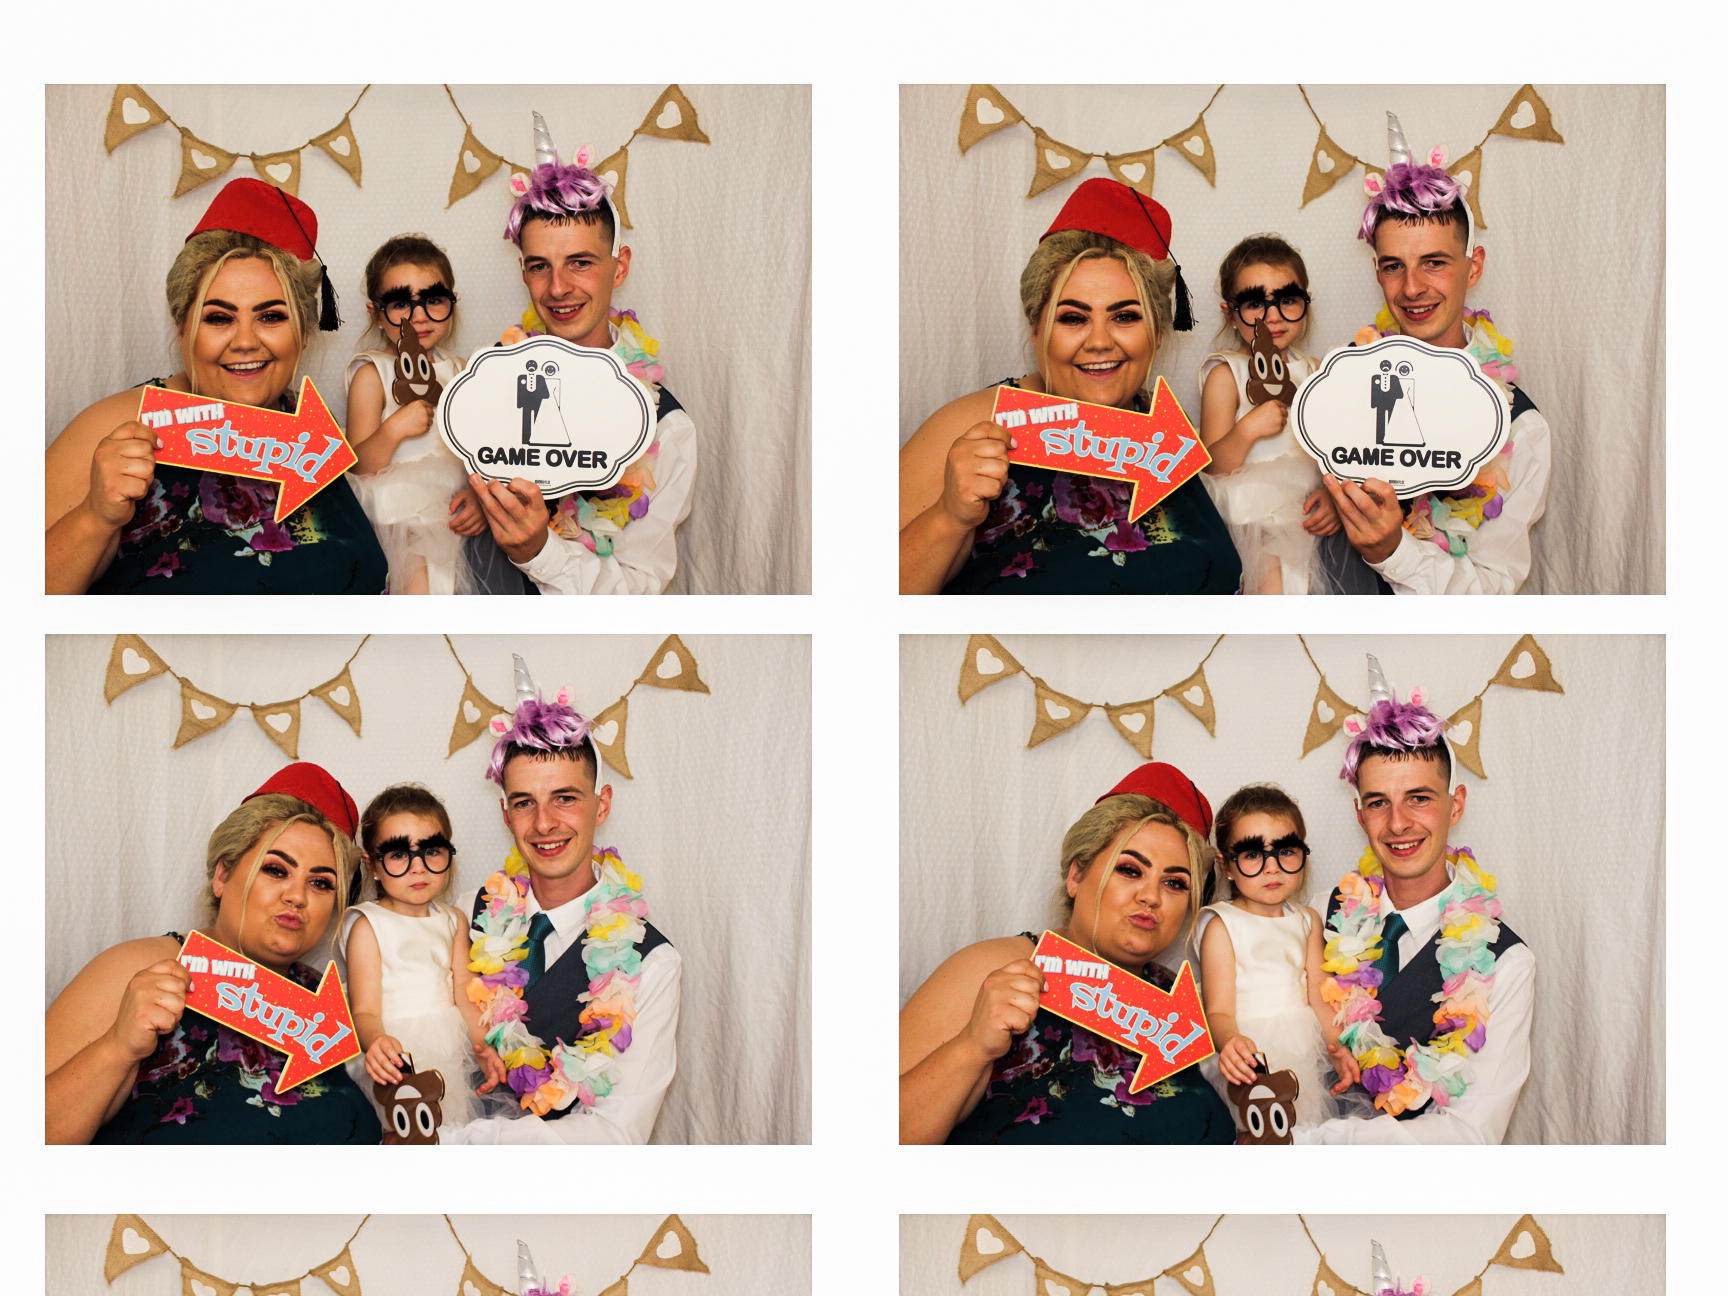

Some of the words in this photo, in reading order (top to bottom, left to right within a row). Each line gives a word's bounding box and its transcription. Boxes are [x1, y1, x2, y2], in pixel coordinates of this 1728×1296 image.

[174, 402, 225, 425] WITH
[1028, 402, 1079, 425] WITH
[185, 420, 344, 484] stupid
[477, 446, 541, 467] GAME
[545, 449, 608, 469] OVER
[1039, 420, 1198, 484] stupid
[1331, 446, 1395, 467] GAME
[1399, 449, 1462, 469] OVER
[211, 958, 256, 980] WITH
[1065, 958, 1110, 980] WITH
[215, 982, 352, 1065] stupid
[1069, 982, 1206, 1065] stupid
